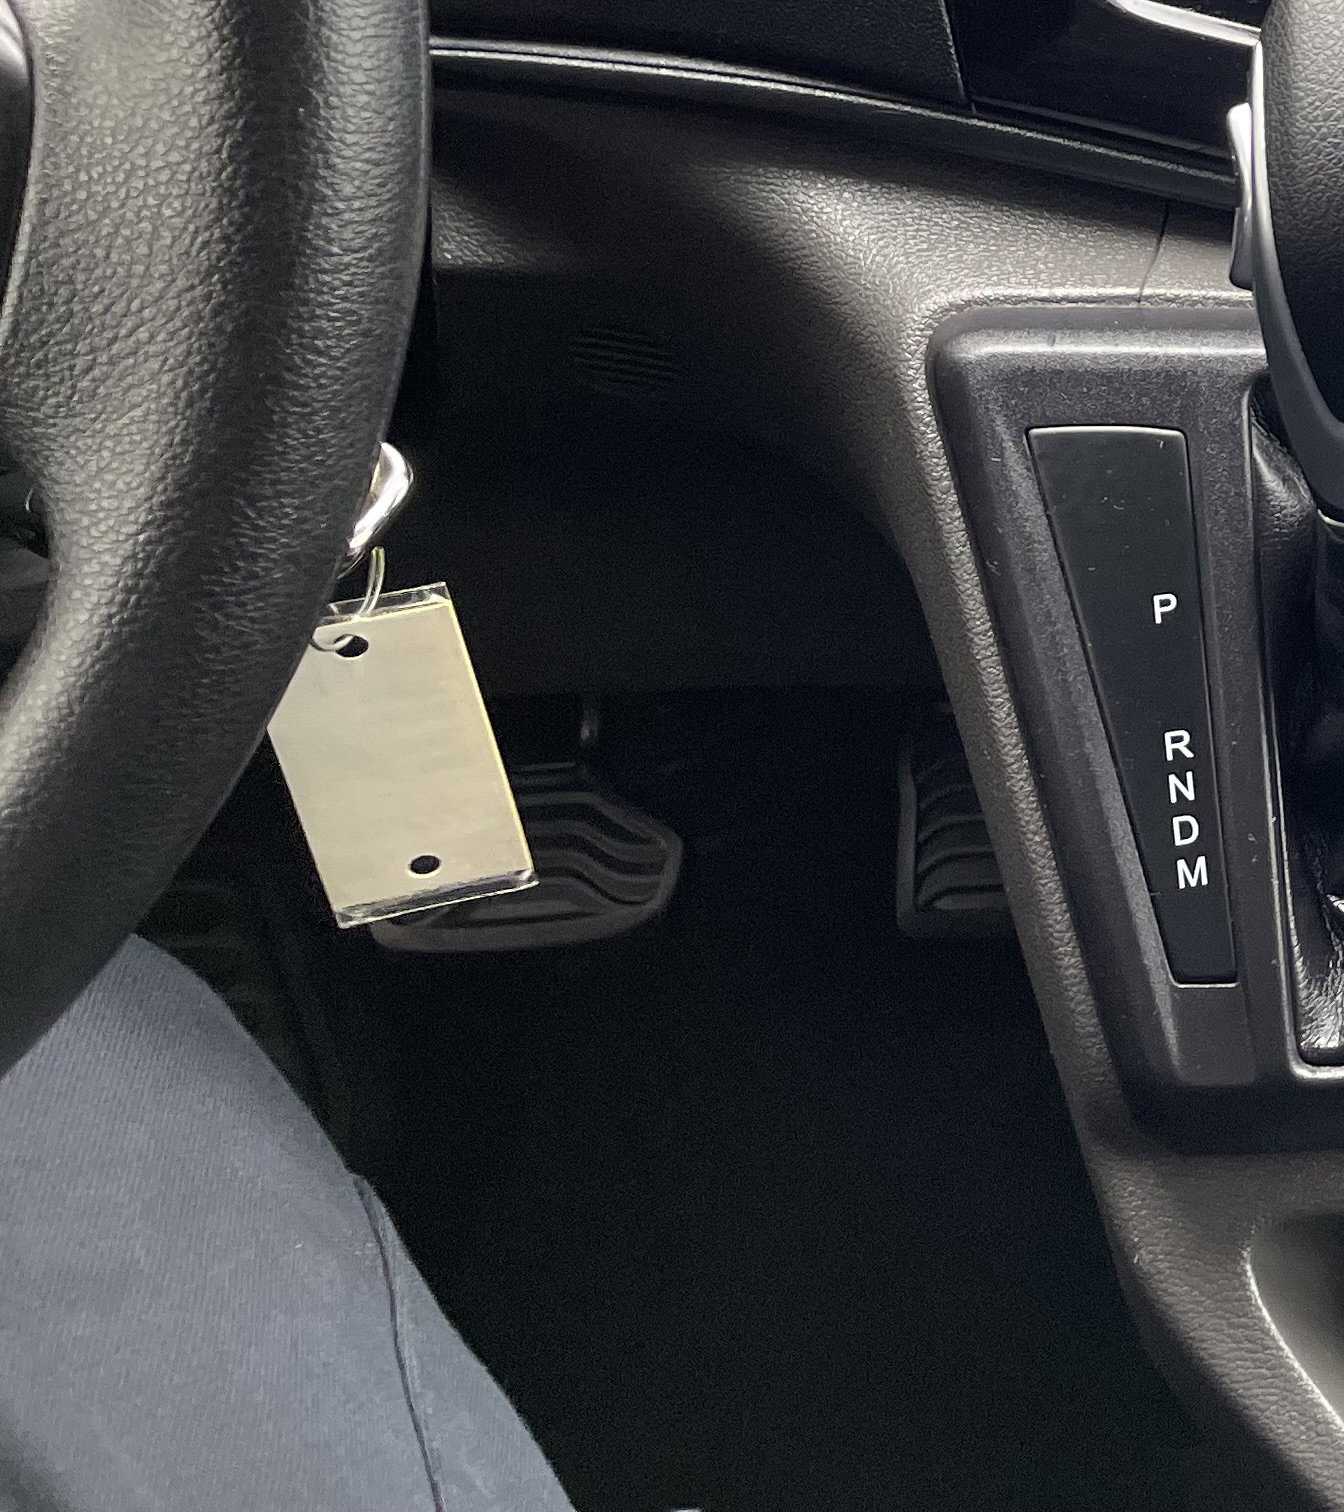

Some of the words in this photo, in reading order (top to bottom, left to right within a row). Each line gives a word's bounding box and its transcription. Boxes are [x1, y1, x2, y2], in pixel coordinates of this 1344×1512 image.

[1153, 593, 1178, 625] P
[1164, 729, 1195, 762] R
[1168, 770, 1195, 804] N
[1172, 815, 1199, 847] D
[1176, 855, 1209, 890] M
